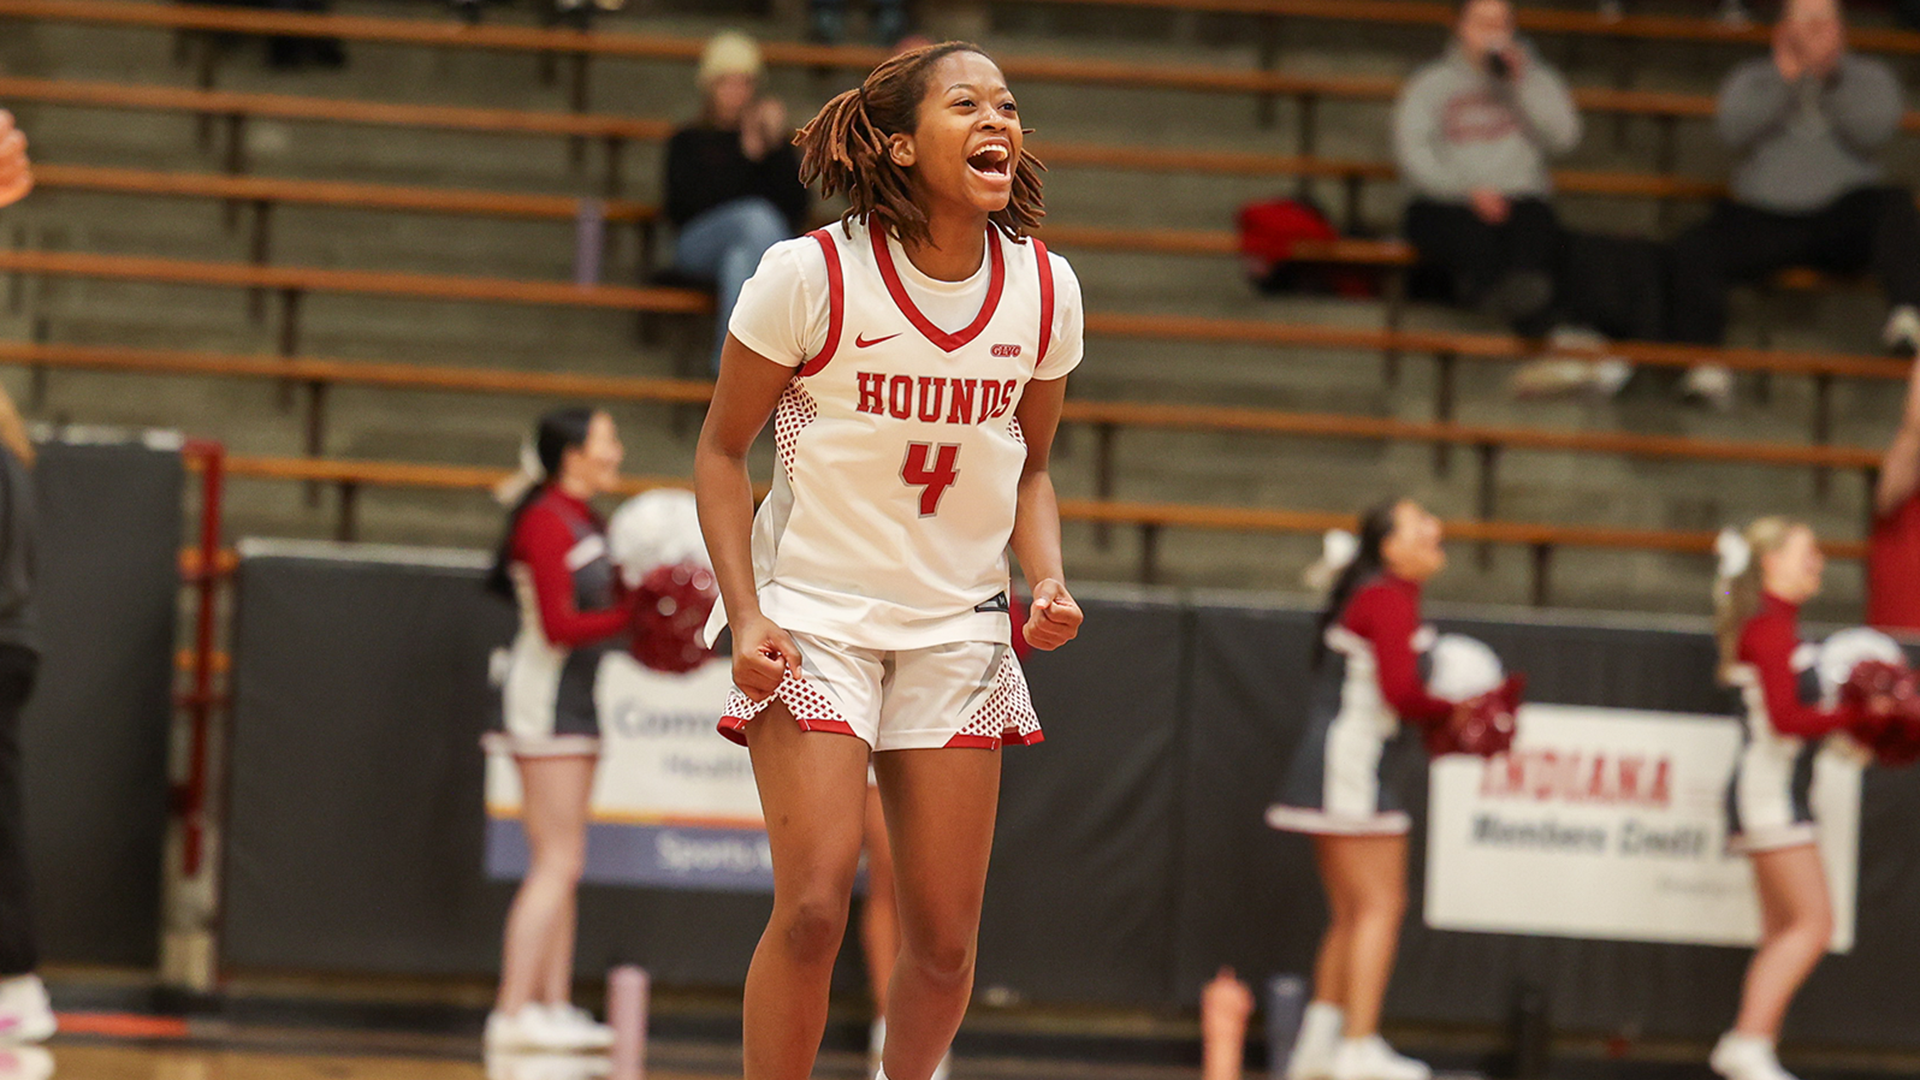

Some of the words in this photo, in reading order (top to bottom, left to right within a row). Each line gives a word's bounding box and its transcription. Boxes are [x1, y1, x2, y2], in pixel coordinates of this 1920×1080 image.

[856, 371, 1017, 426] HOUNDS
[898, 440, 962, 519] 4
[1480, 747, 1672, 808] INDIANA
